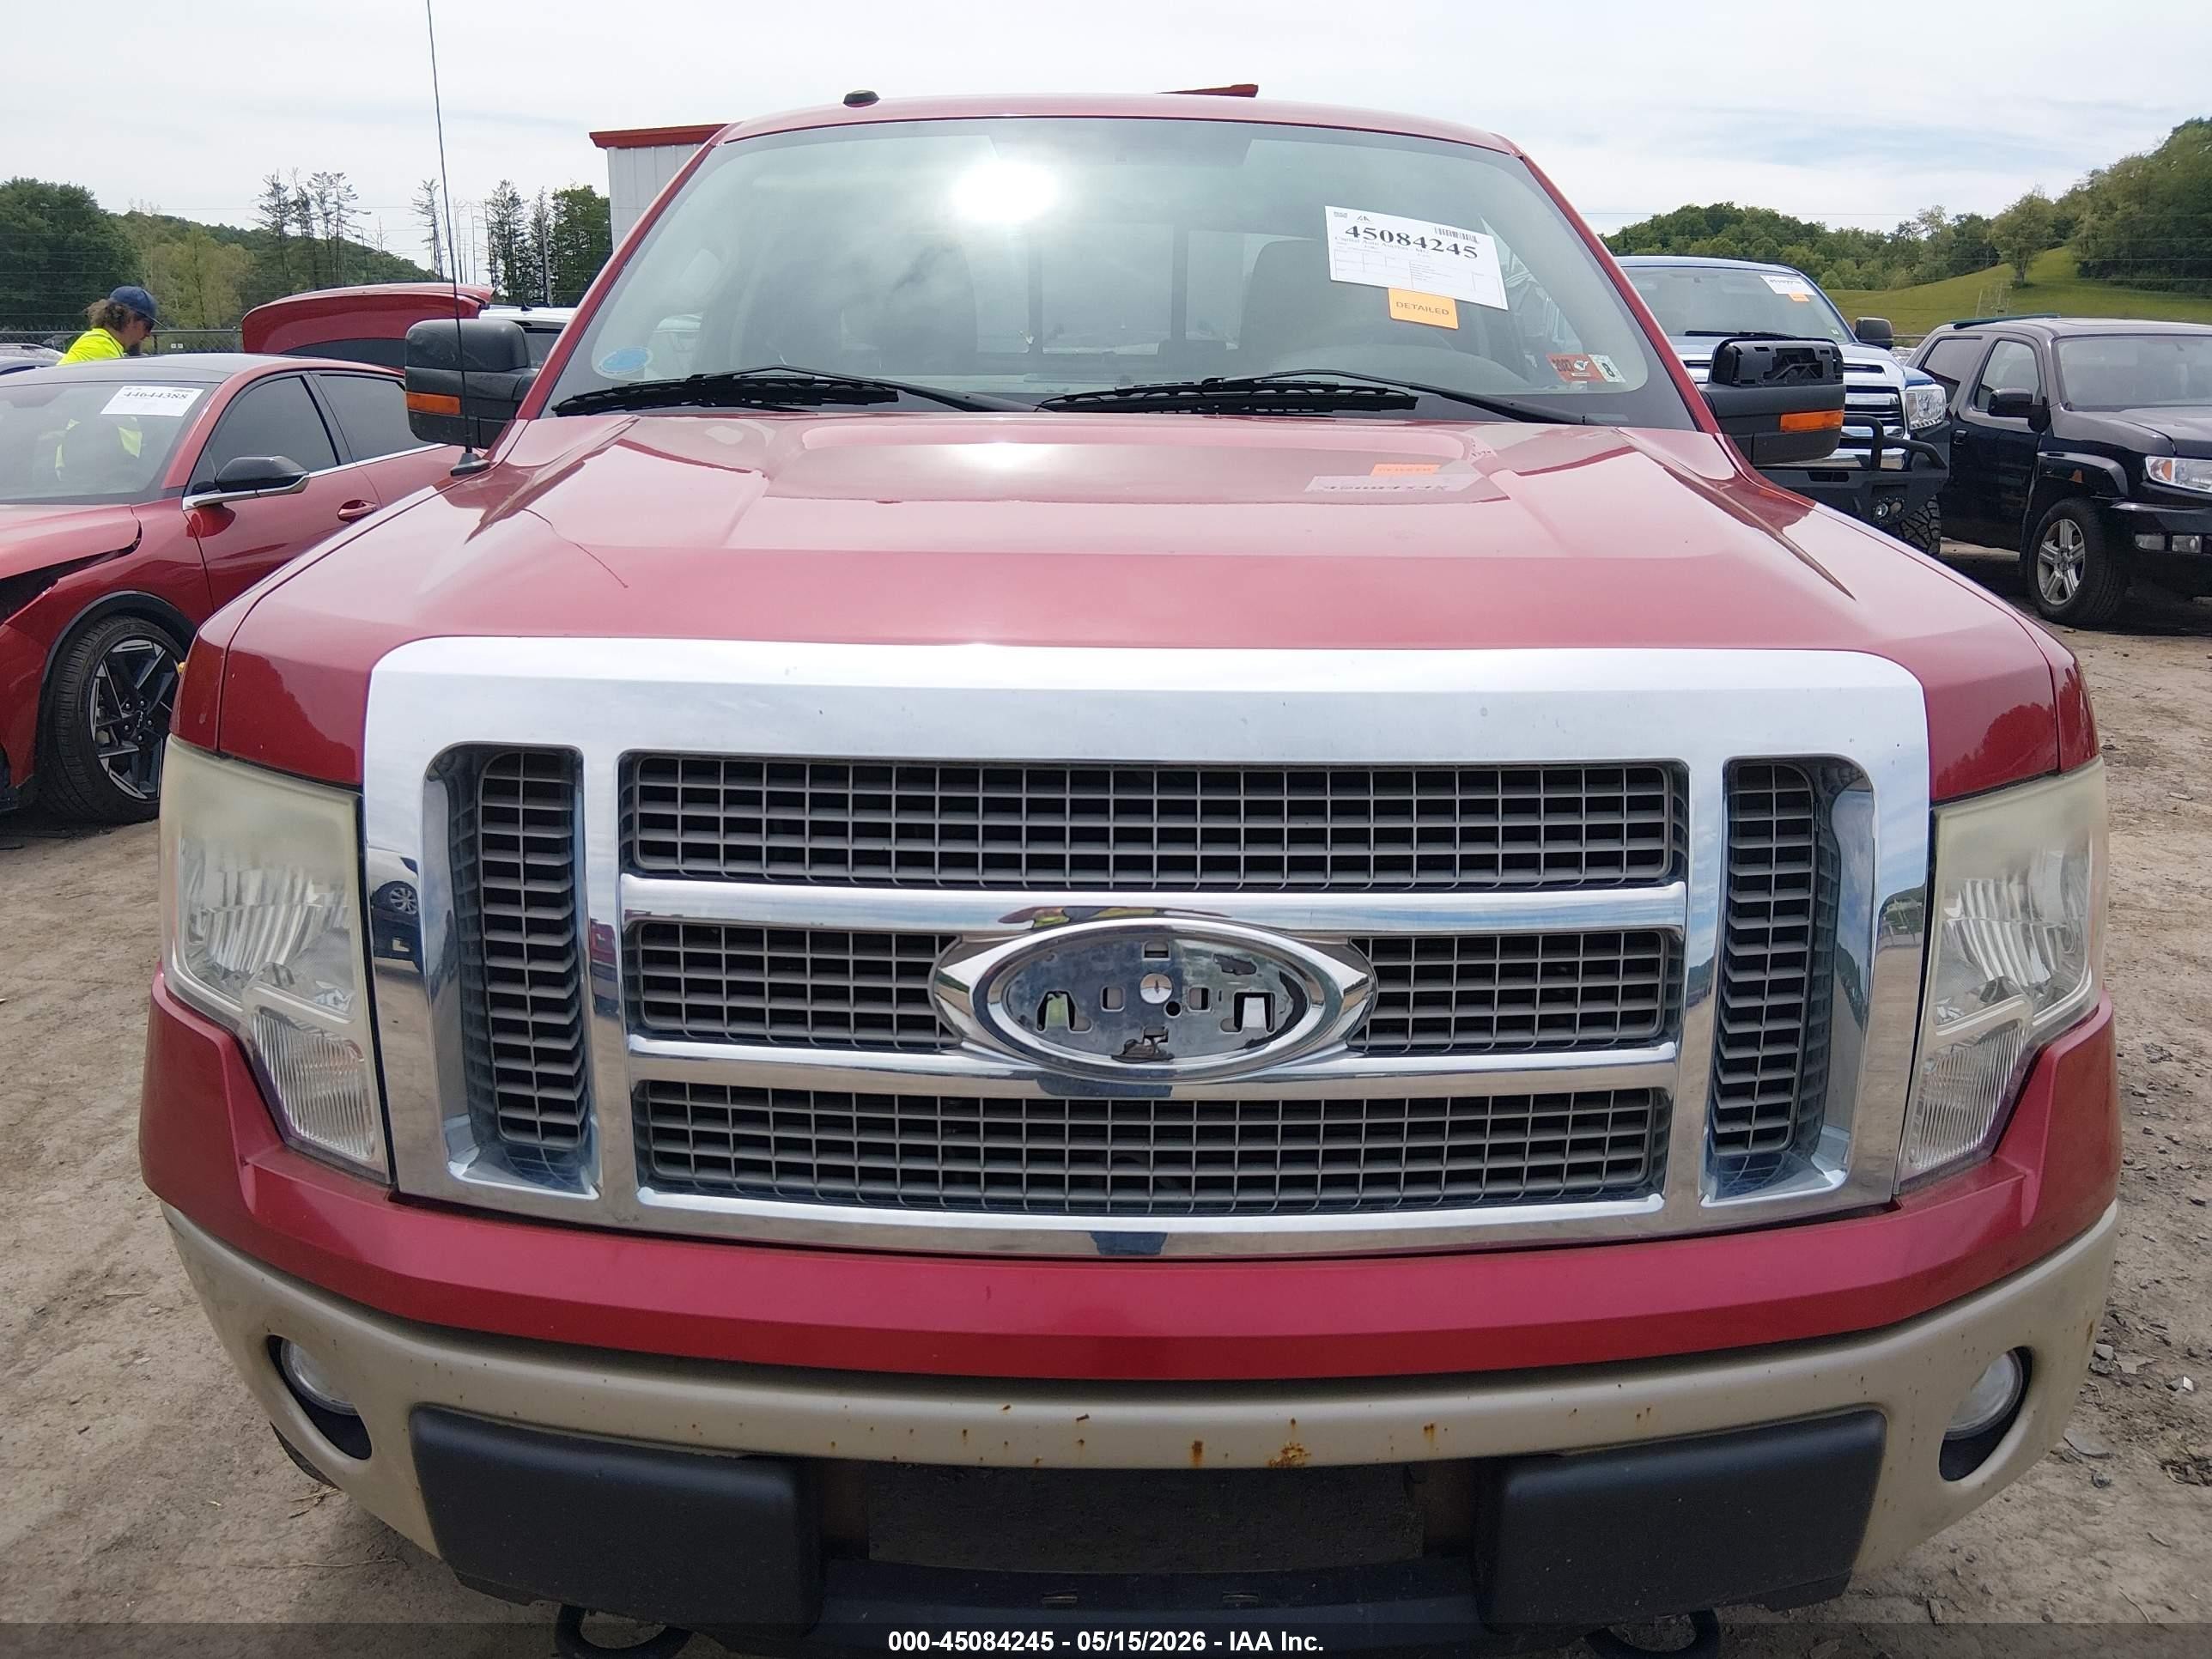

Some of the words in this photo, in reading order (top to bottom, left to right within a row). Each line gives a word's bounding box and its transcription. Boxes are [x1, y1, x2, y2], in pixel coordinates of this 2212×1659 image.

[1345, 225, 1478, 259] 45084245
[1395, 301, 1449, 316] DETAILED
[1601, 362, 1616, 378] 8
